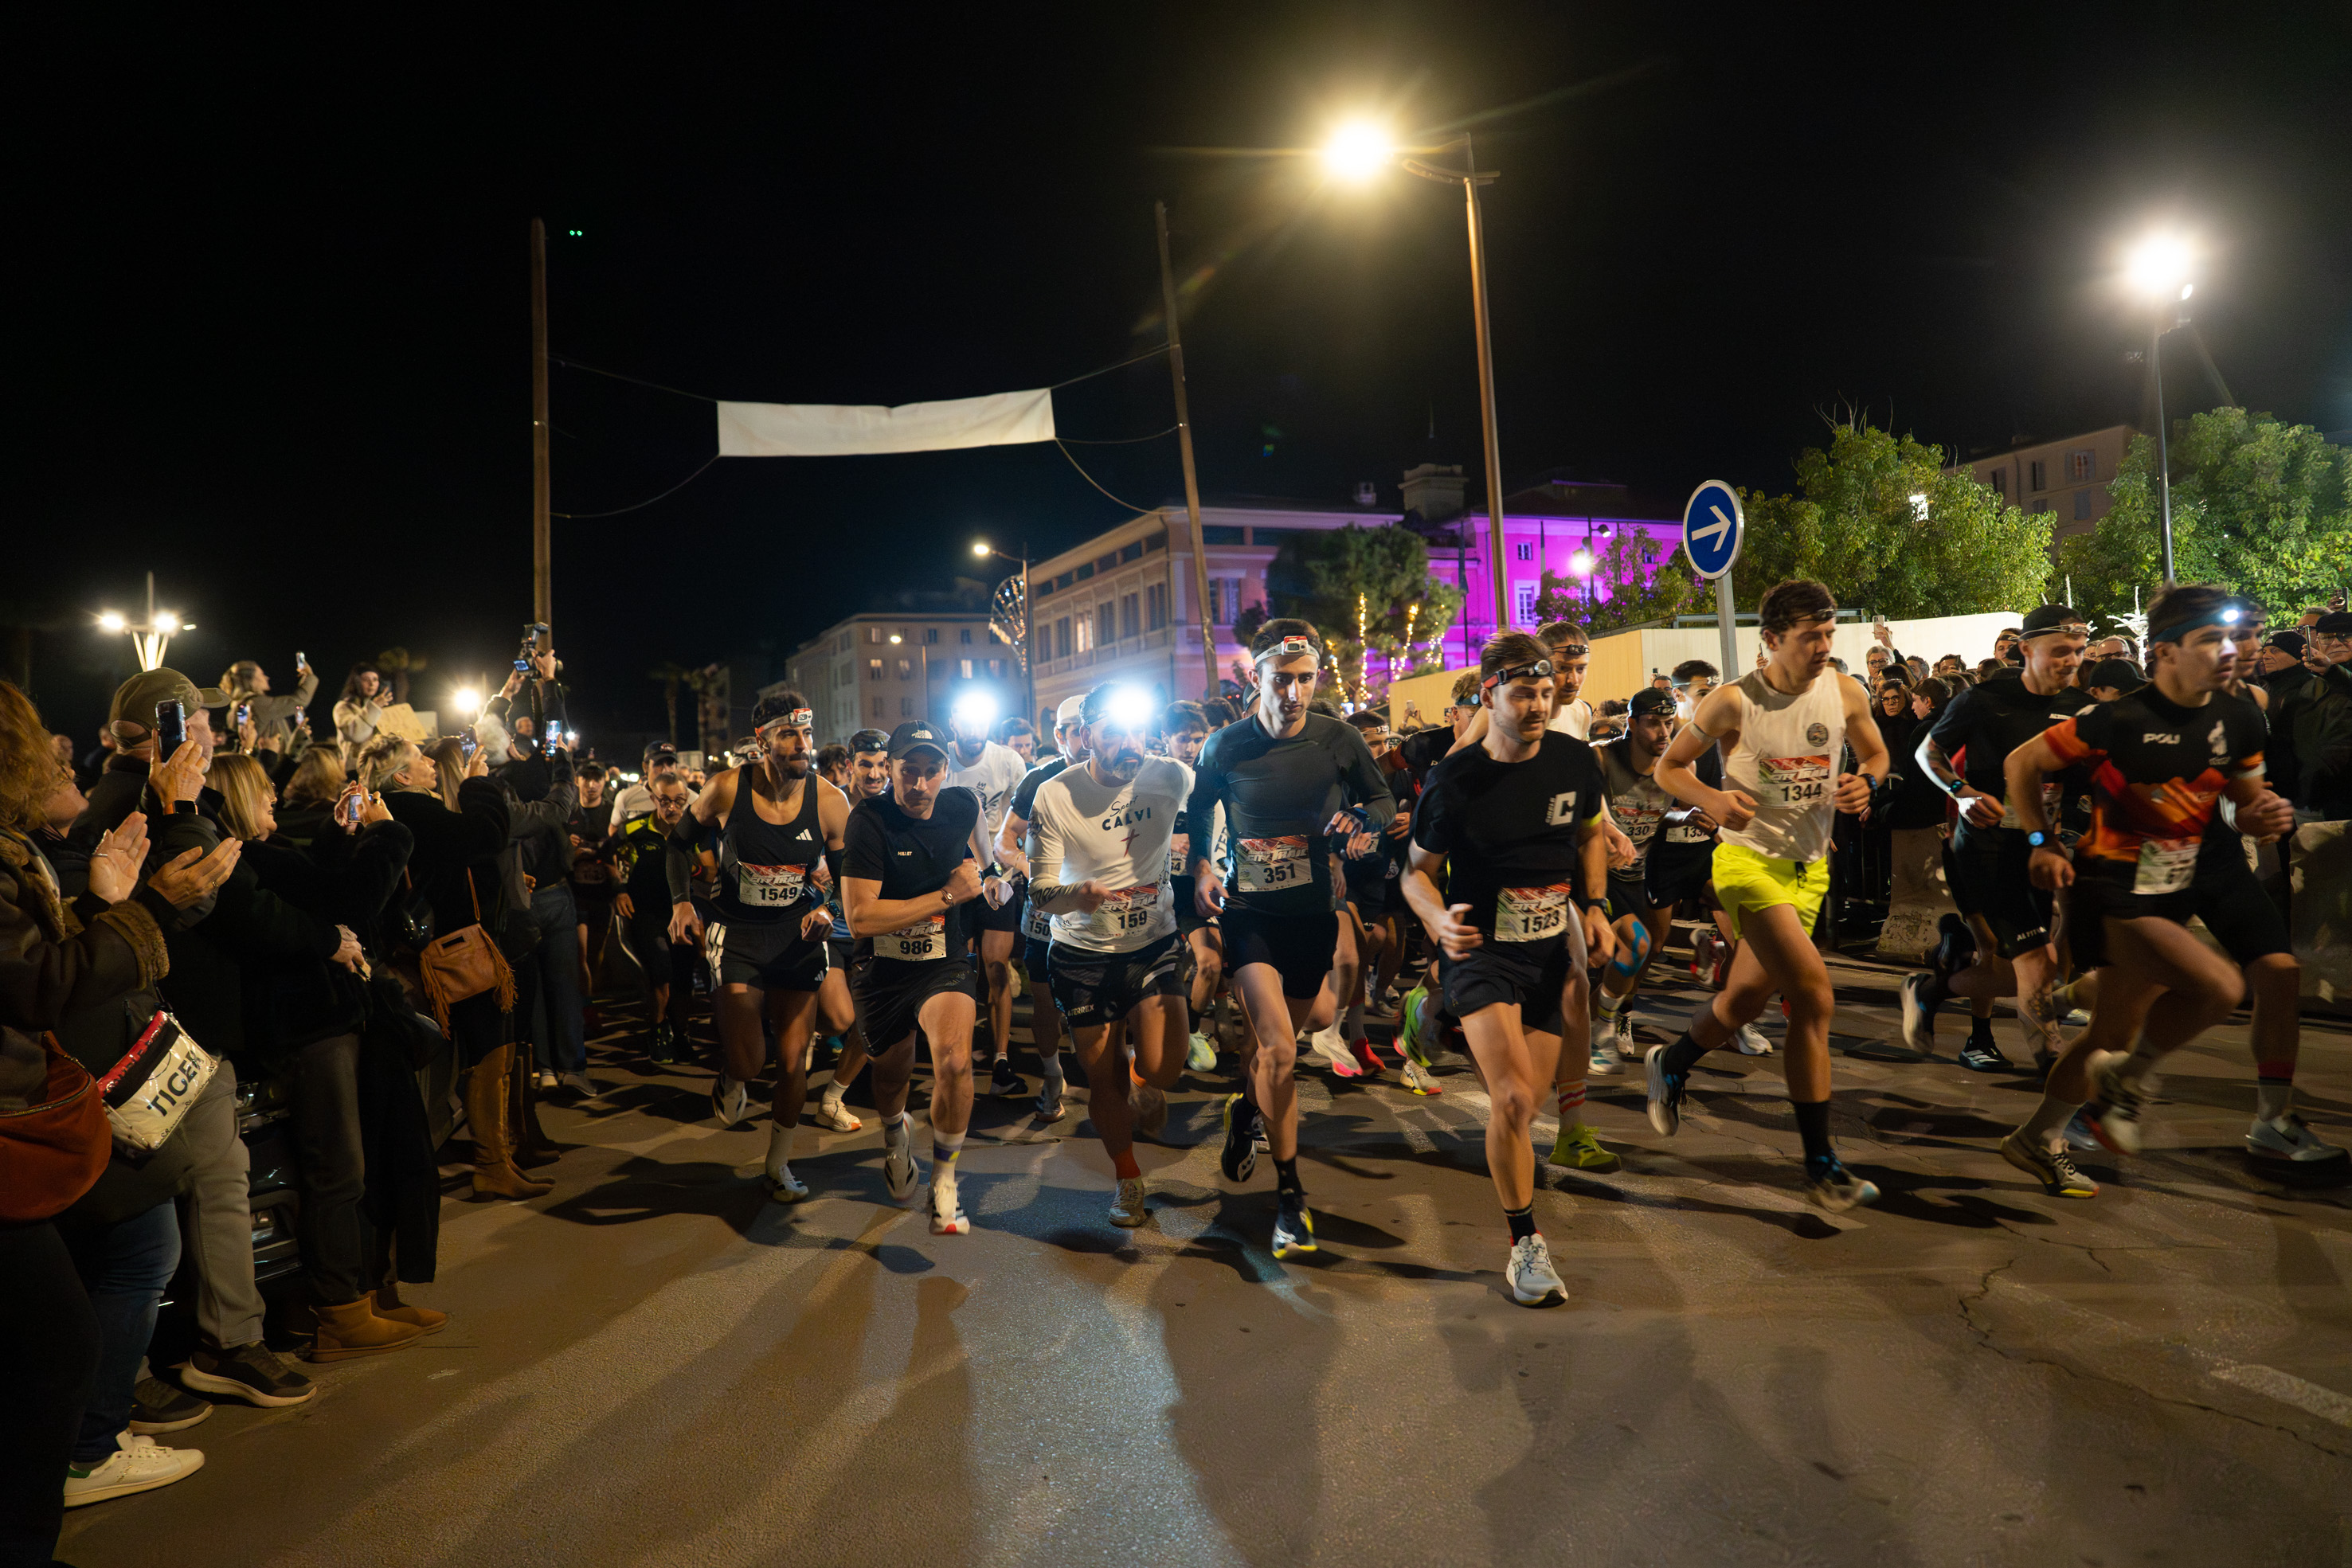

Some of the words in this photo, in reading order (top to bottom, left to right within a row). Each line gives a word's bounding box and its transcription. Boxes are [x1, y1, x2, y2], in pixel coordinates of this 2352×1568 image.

[1781, 783, 1822, 802] 1344
[1110, 795, 1138, 817] Sport
[1102, 807, 1151, 831] CALVI
[1626, 825, 1650, 836] 330
[1263, 863, 1296, 884] 351
[759, 886, 797, 901] 1549
[1030, 920, 1052, 937] 150
[1117, 910, 1148, 929] 159
[1521, 909, 1560, 933] 1523
[899, 939, 933, 955] 986
